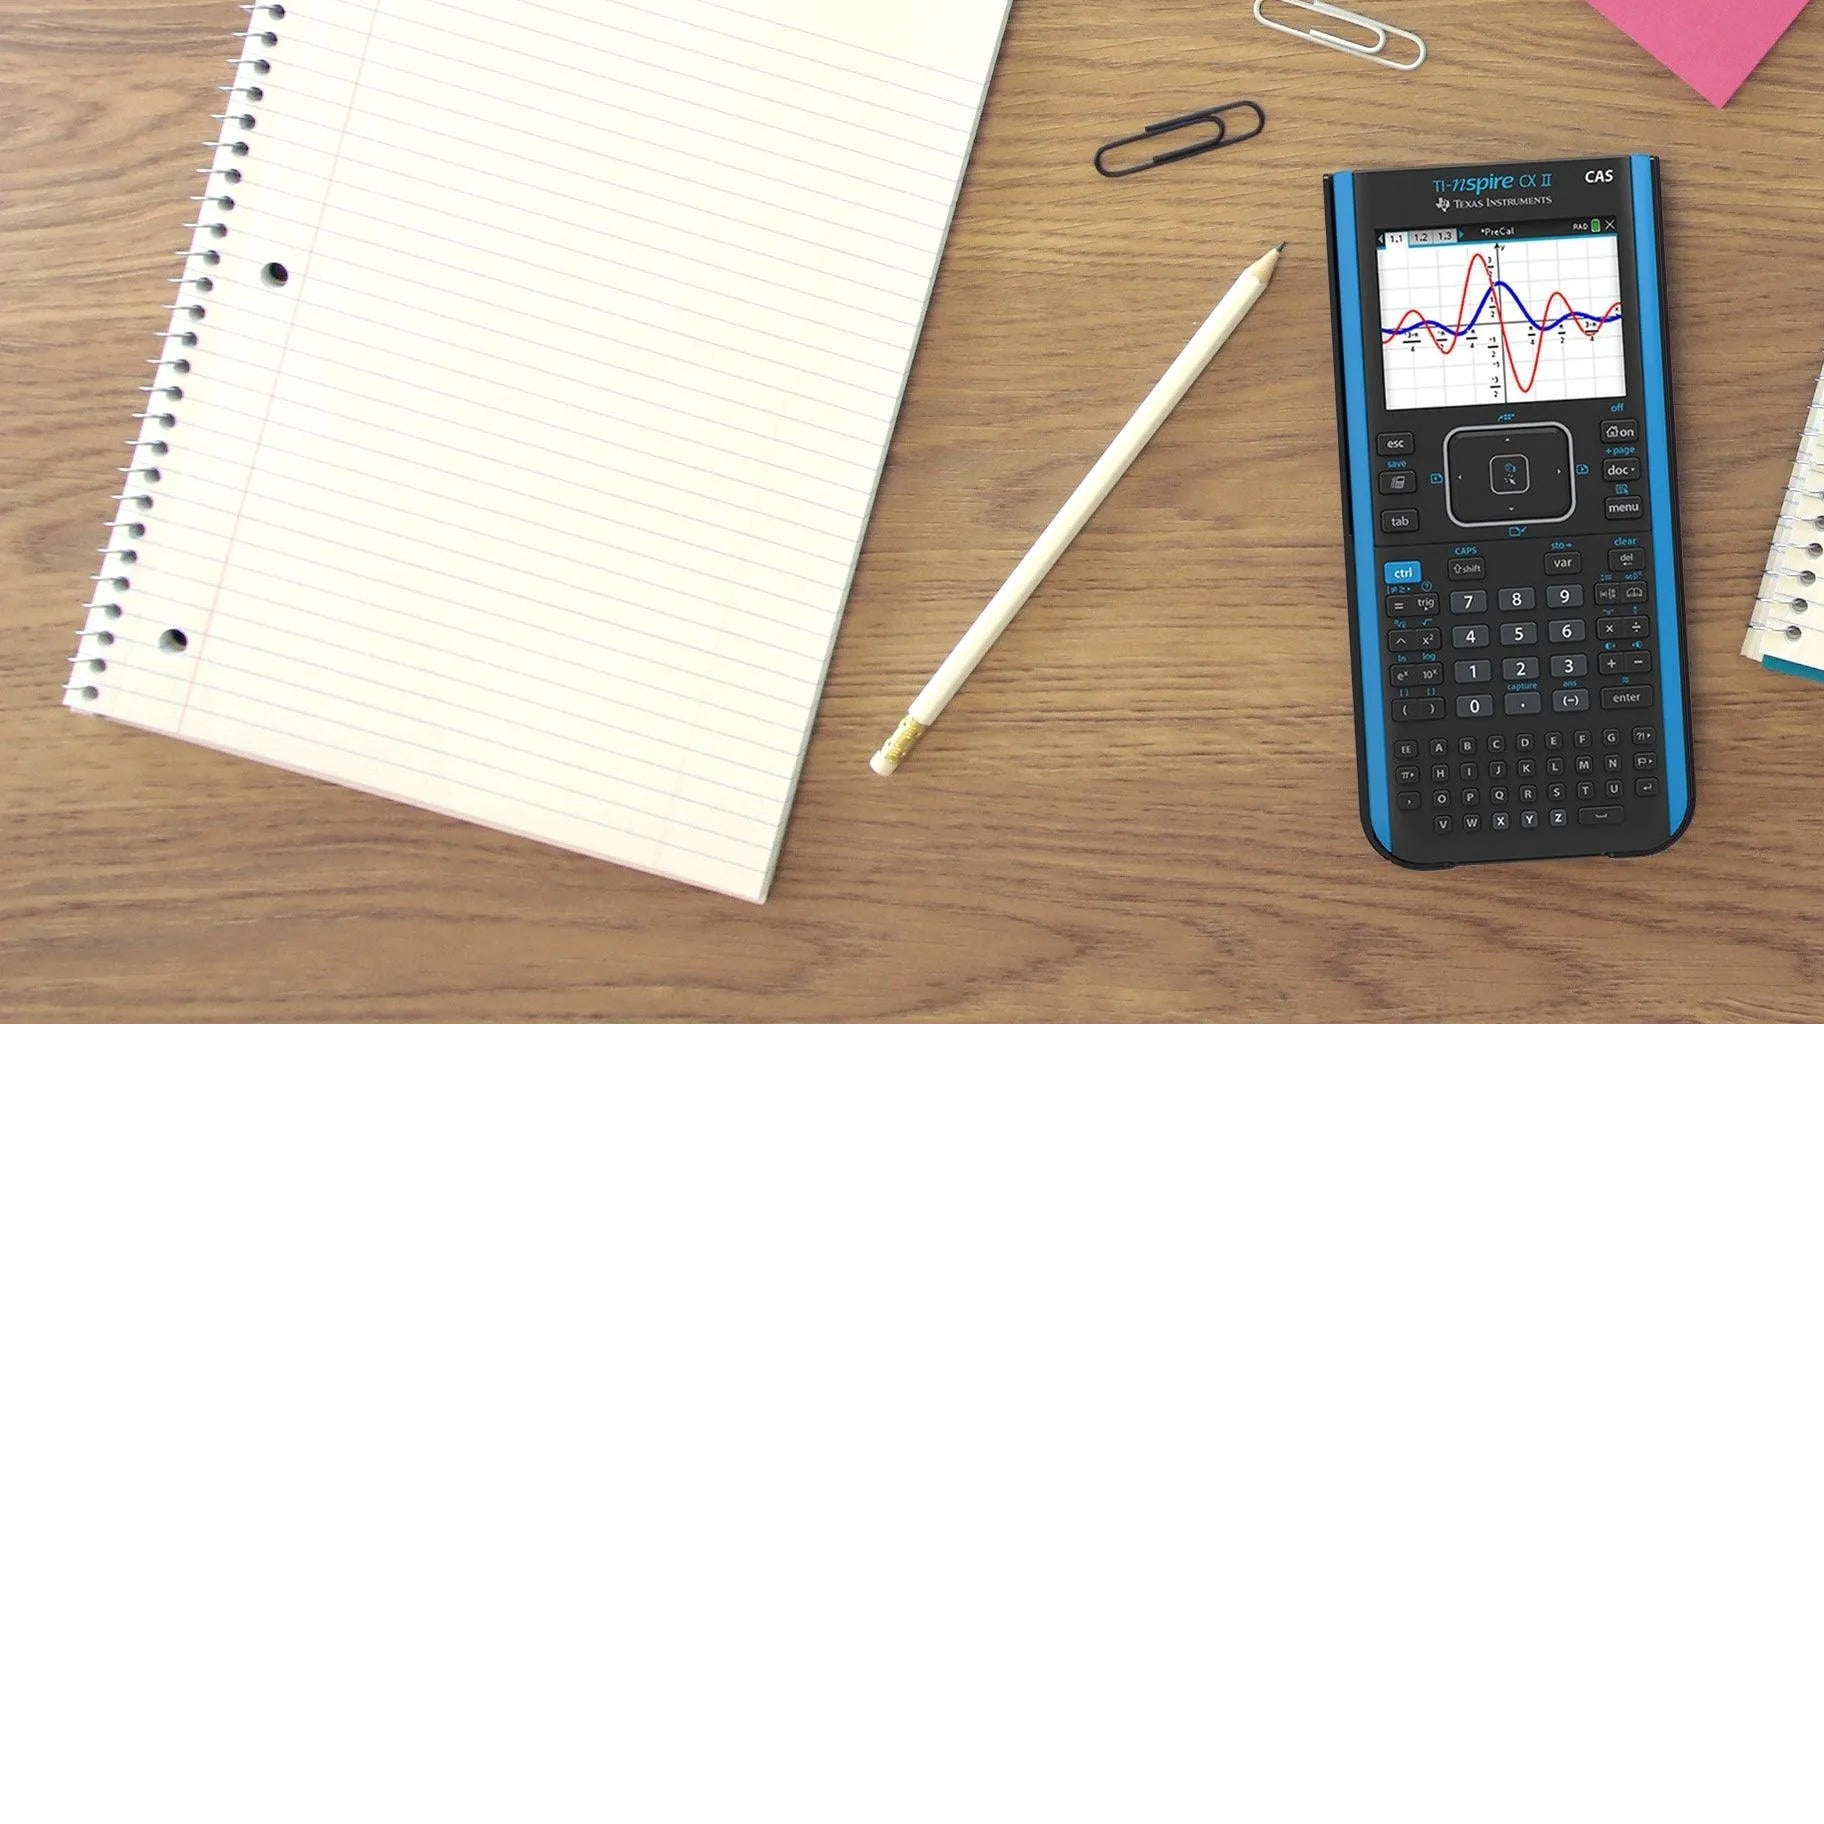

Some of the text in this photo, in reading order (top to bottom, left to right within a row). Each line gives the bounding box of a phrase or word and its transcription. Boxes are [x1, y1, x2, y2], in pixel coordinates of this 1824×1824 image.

[1519, 174, 1536, 187] CX
[1584, 169, 1613, 183] CAS
[1453, 195, 1552, 208] TEXAS INSTRUMENTS
[1390, 234, 1402, 243] 1.1
[1414, 232, 1427, 241] 1.2
[1438, 231, 1452, 240] 1.3
[1610, 403, 1624, 412] off
[1619, 428, 1634, 437] on
[1387, 440, 1403, 448] esc
[1387, 460, 1406, 468] save
[1607, 465, 1628, 475] doc
[1608, 503, 1639, 512] menu
[1391, 516, 1409, 526] tab
[1613, 537, 1636, 546] clear
[1454, 546, 1477, 555] CAPS
[1619, 553, 1633, 562] del
[1553, 559, 1572, 567] var
[1394, 567, 1412, 578] ctrl
[1462, 564, 1480, 573] shift
[1512, 592, 1521, 606] 8
[1559, 589, 1569, 603] 9
[1417, 597, 1434, 608] trig
[1464, 595, 1472, 608] 7
[1514, 627, 1523, 640] 5
[1562, 624, 1572, 638] 6
[1465, 630, 1476, 643] 4
[1516, 662, 1525, 675] 2
[1564, 659, 1573, 673] 3
[1469, 665, 1476, 678] 1
[1506, 682, 1537, 691] capture
[1612, 693, 1640, 702] enter
[1469, 699, 1479, 713] 0
